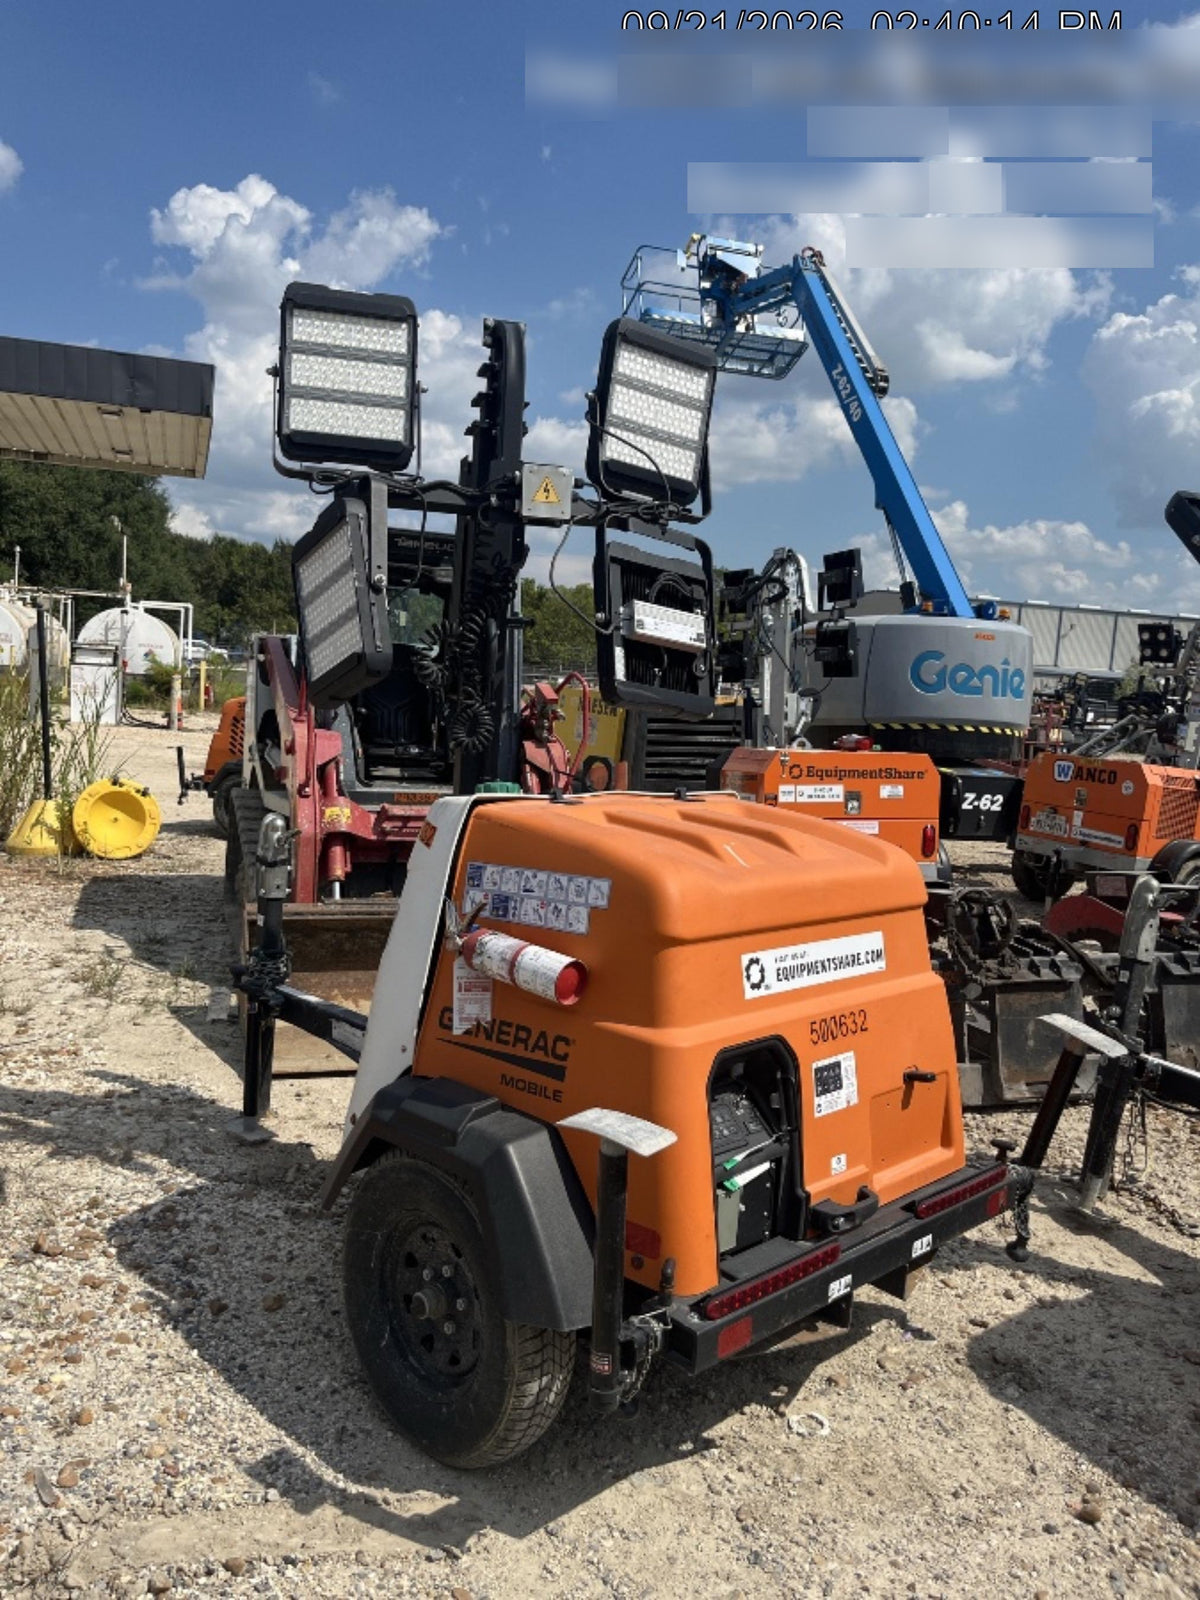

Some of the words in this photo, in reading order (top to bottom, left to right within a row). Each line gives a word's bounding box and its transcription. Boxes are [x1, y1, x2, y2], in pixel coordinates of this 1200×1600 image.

[909, 649, 1026, 701] Genie
[805, 765, 925, 781] EquipmentShare
[1055, 760, 1118, 785] WANCO
[961, 791, 1004, 811] Z-62
[776, 948, 883, 982] EQUIPMENTSHARE.COM
[438, 1005, 571, 1062] GNERAC
[810, 1009, 868, 1046] 500632
[500, 1073, 564, 1103] MOBILE
